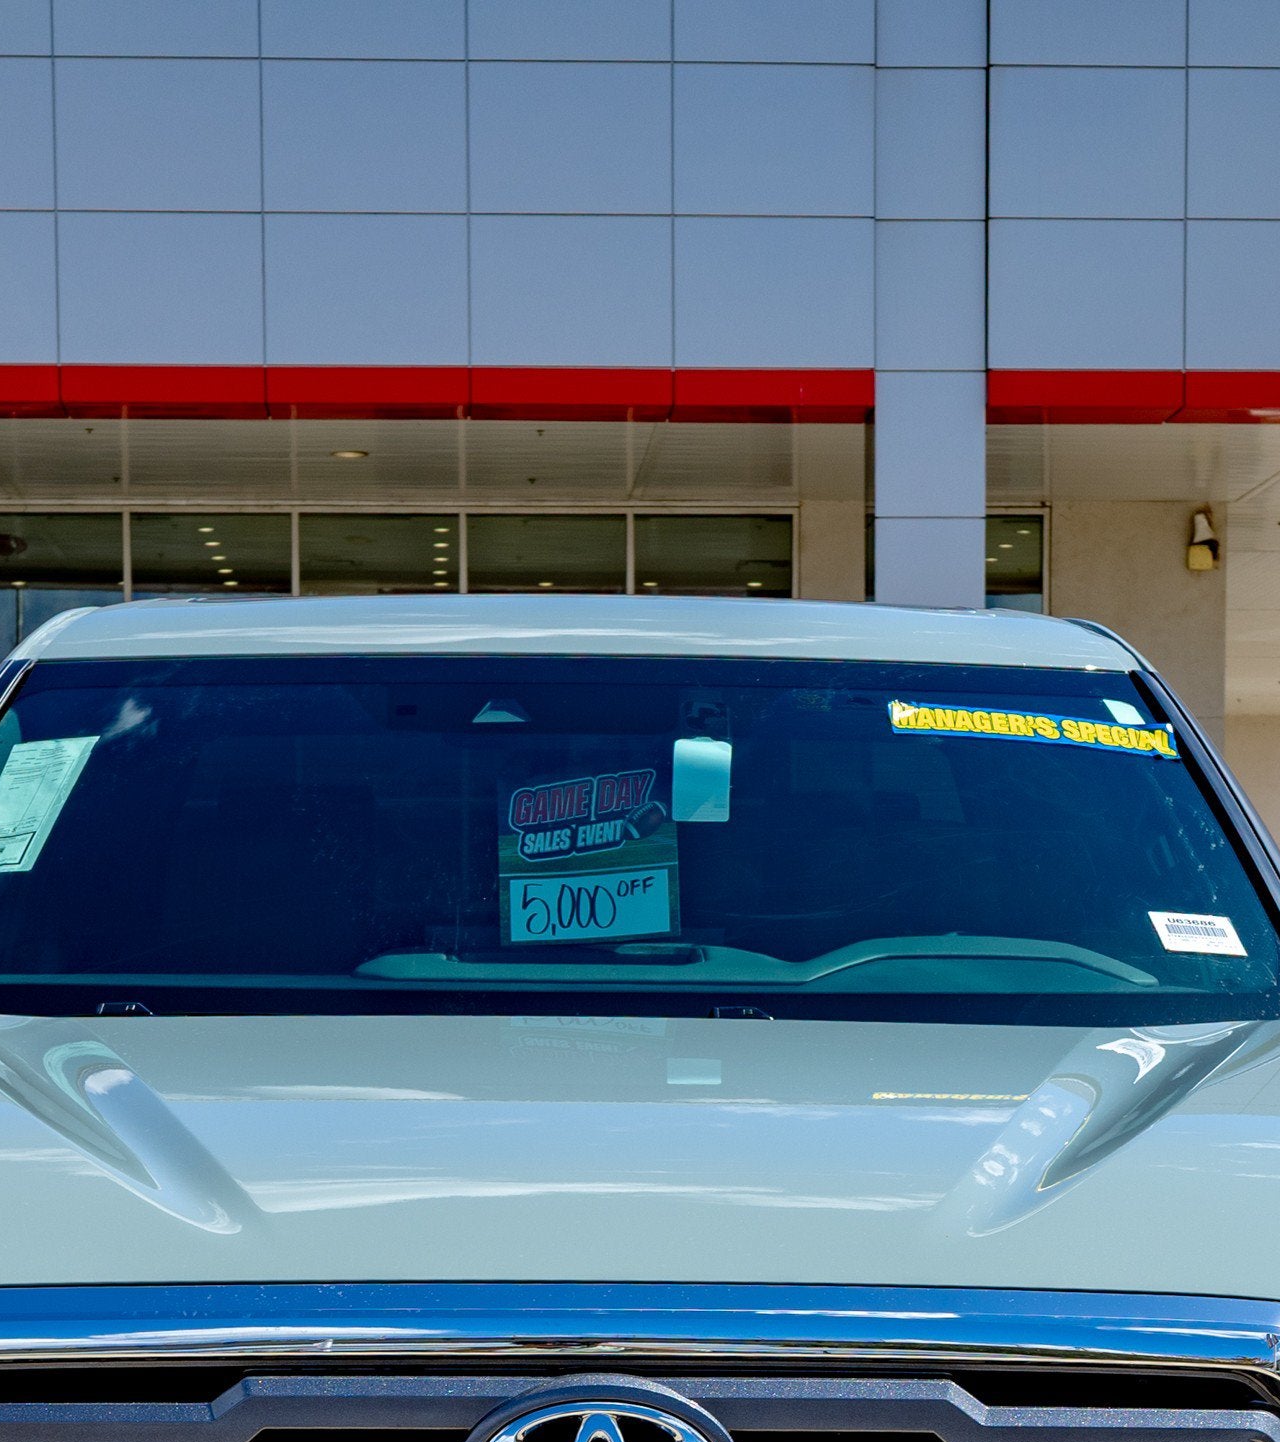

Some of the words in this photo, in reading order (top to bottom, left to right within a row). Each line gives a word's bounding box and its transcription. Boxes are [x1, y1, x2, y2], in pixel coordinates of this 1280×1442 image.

[892, 701, 1060, 740] MANAGER'S
[1063, 721, 1177, 757] SPECIAL
[514, 782, 590, 826] GAME
[597, 774, 651, 812] DAY
[523, 828, 571, 854] SALES
[576, 819, 625, 848] EVENT
[521, 883, 616, 936] 5,000
[617, 876, 655, 898] OFF
